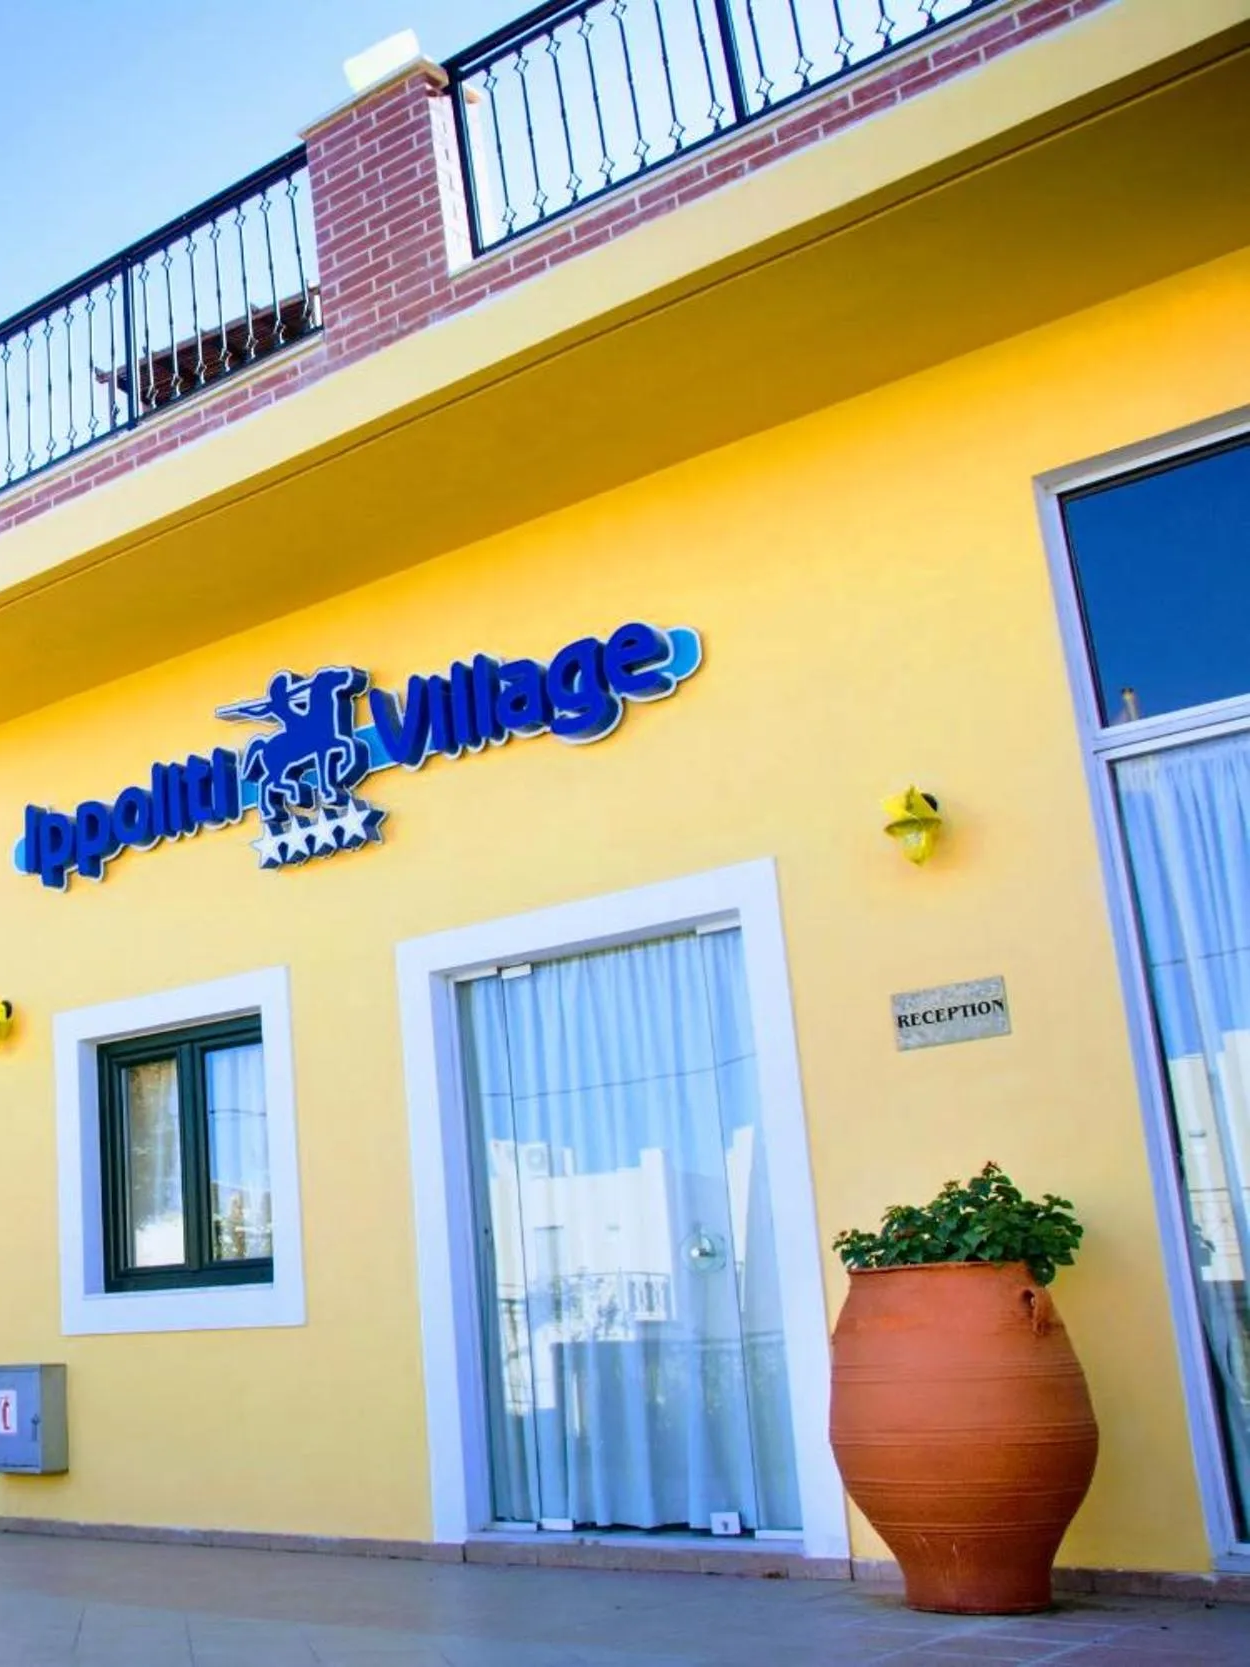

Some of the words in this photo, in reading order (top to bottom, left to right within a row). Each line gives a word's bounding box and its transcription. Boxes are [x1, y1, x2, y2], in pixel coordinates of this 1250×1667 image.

[23, 746, 240, 890] Ippoliti
[368, 621, 674, 768] Village
[897, 999, 1005, 1028] RECEPTION
